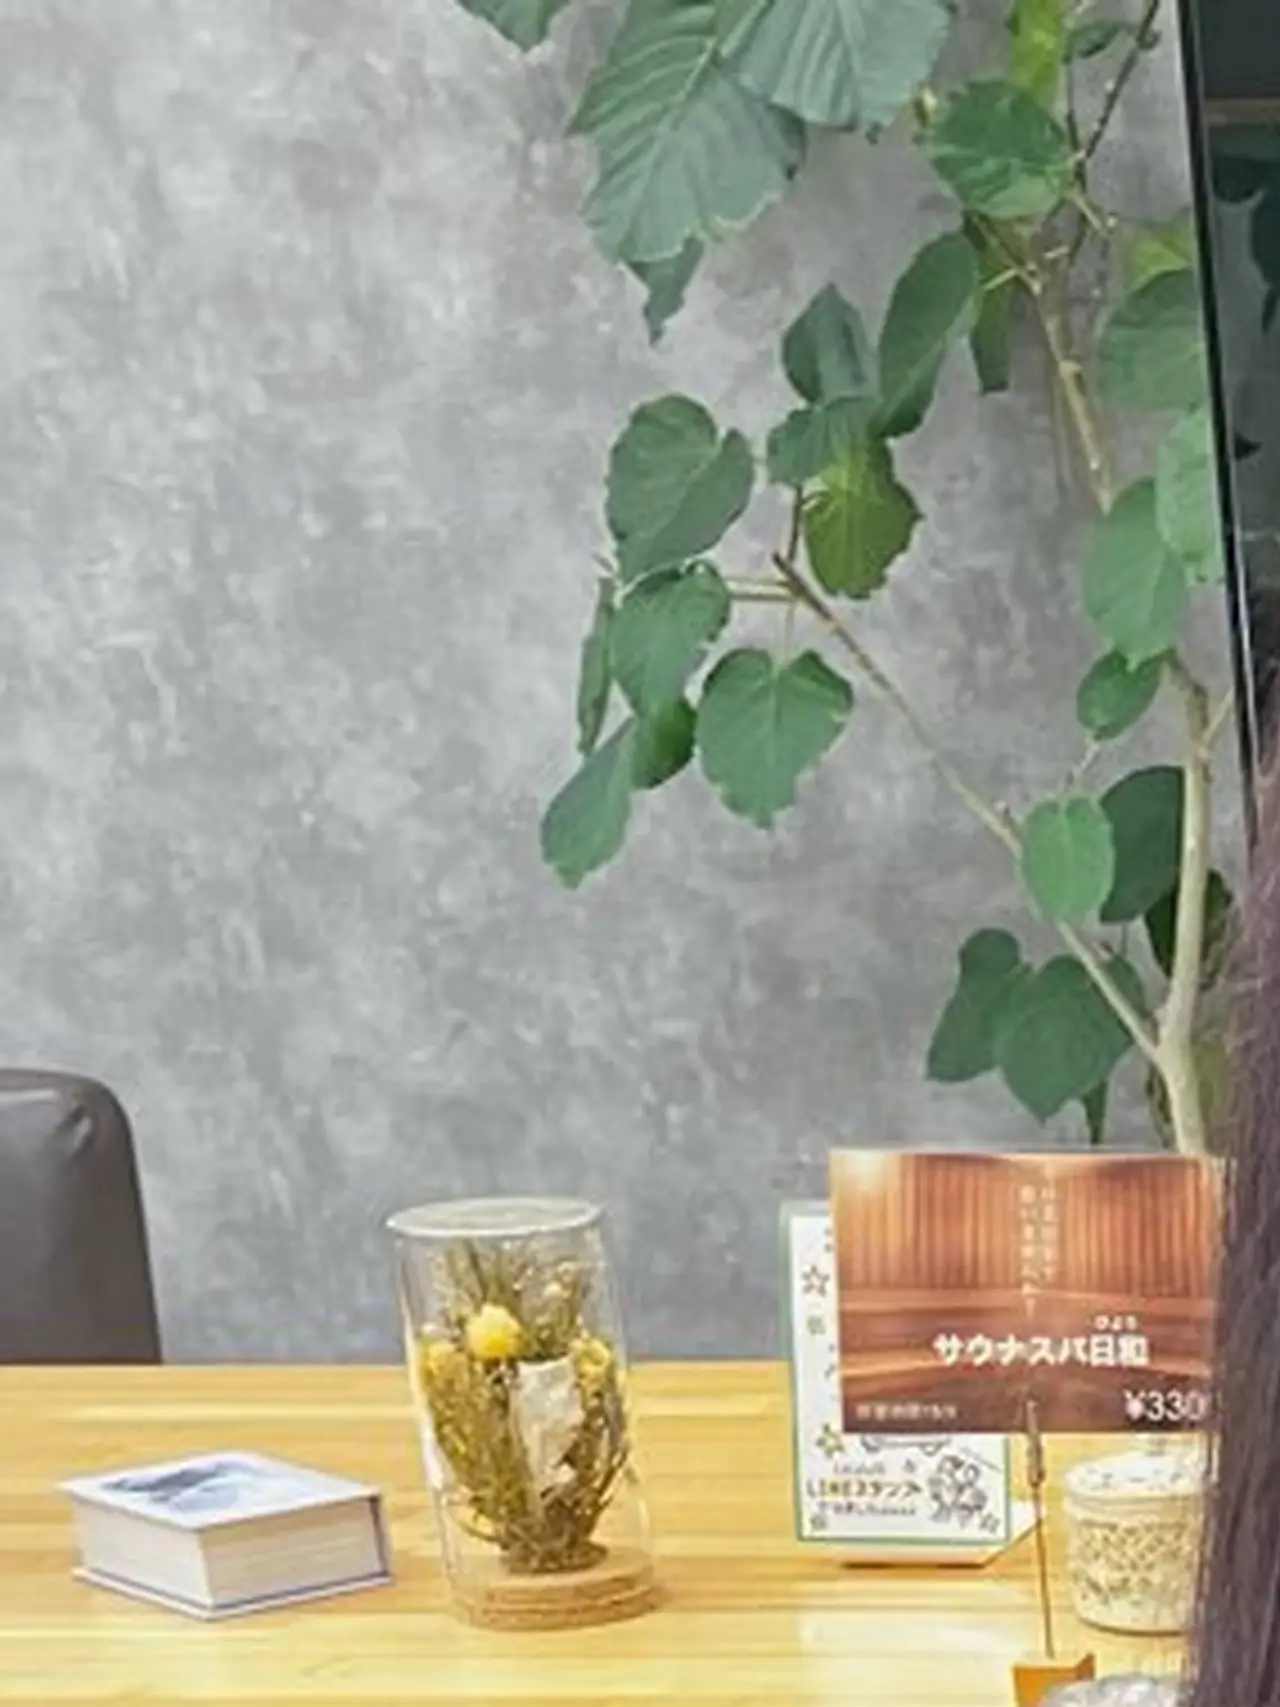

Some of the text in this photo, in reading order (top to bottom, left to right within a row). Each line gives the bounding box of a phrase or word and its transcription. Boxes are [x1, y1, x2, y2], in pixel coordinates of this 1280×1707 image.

[933, 1334, 1149, 1366] サウナスパ日和
